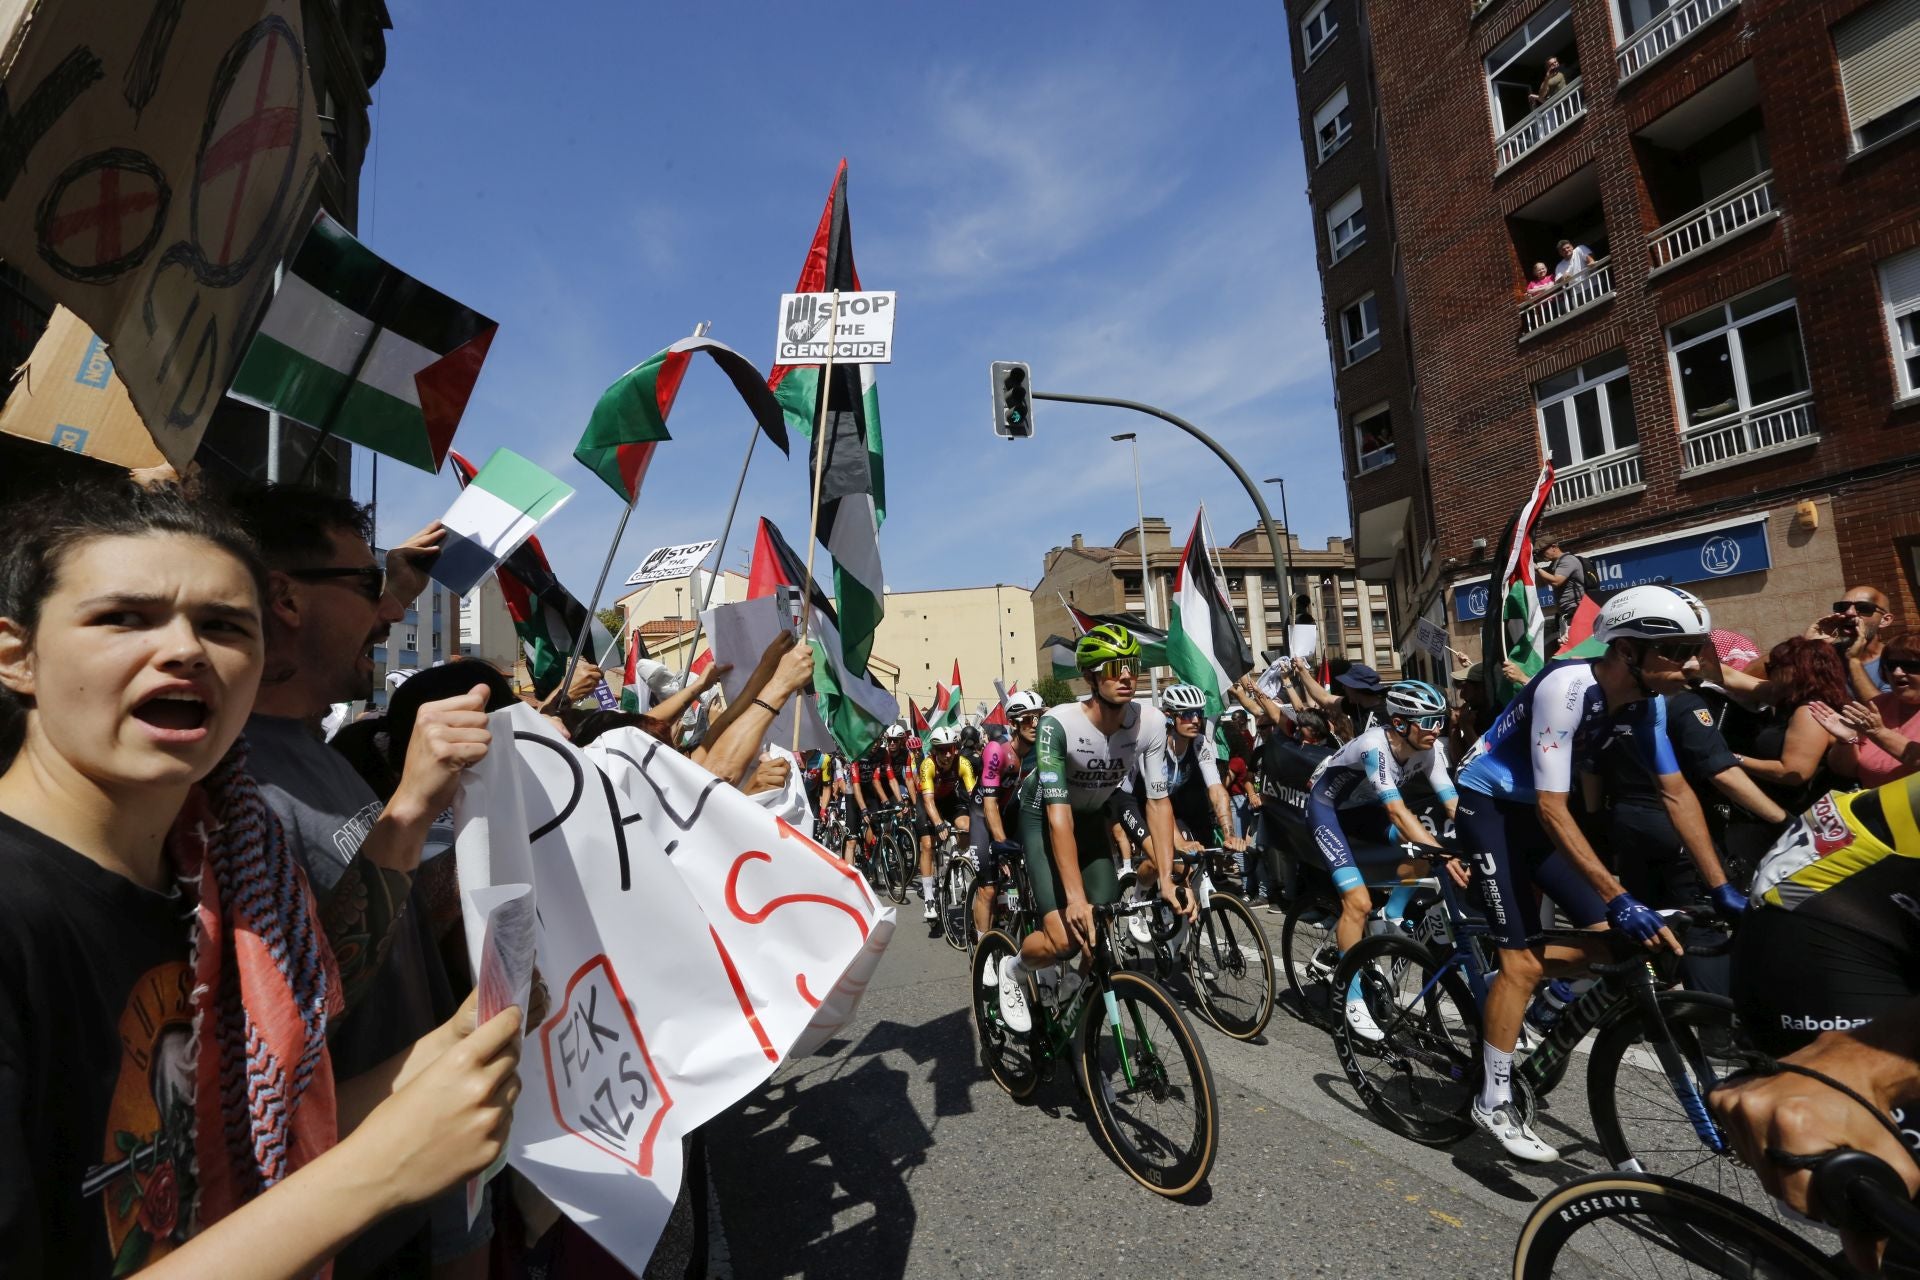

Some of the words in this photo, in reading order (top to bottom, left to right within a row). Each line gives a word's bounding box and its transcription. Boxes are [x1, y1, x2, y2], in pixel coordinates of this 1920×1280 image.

[818, 296, 890, 318] STOP
[834, 324, 865, 336] THE
[782, 343, 885, 358] GENOCIDE
[668, 542, 712, 558] STOP
[668, 558, 689, 566] THE
[633, 566, 692, 580] GENOCIDE
[1497, 703, 1526, 739] FACTOR
[1040, 724, 1055, 765] ALEA
[984, 753, 1000, 780] lotto
[1087, 758, 1126, 770] CAJA
[1378, 751, 1389, 786] MERIDA
[1480, 879, 1494, 908] TECH
[1486, 879, 1507, 925] PREMIER
[556, 985, 620, 1088] FCK
[1530, 976, 1619, 1078] FACTOR
[579, 1051, 649, 1151] NZS
[1559, 1195, 1642, 1223] RESERVE
